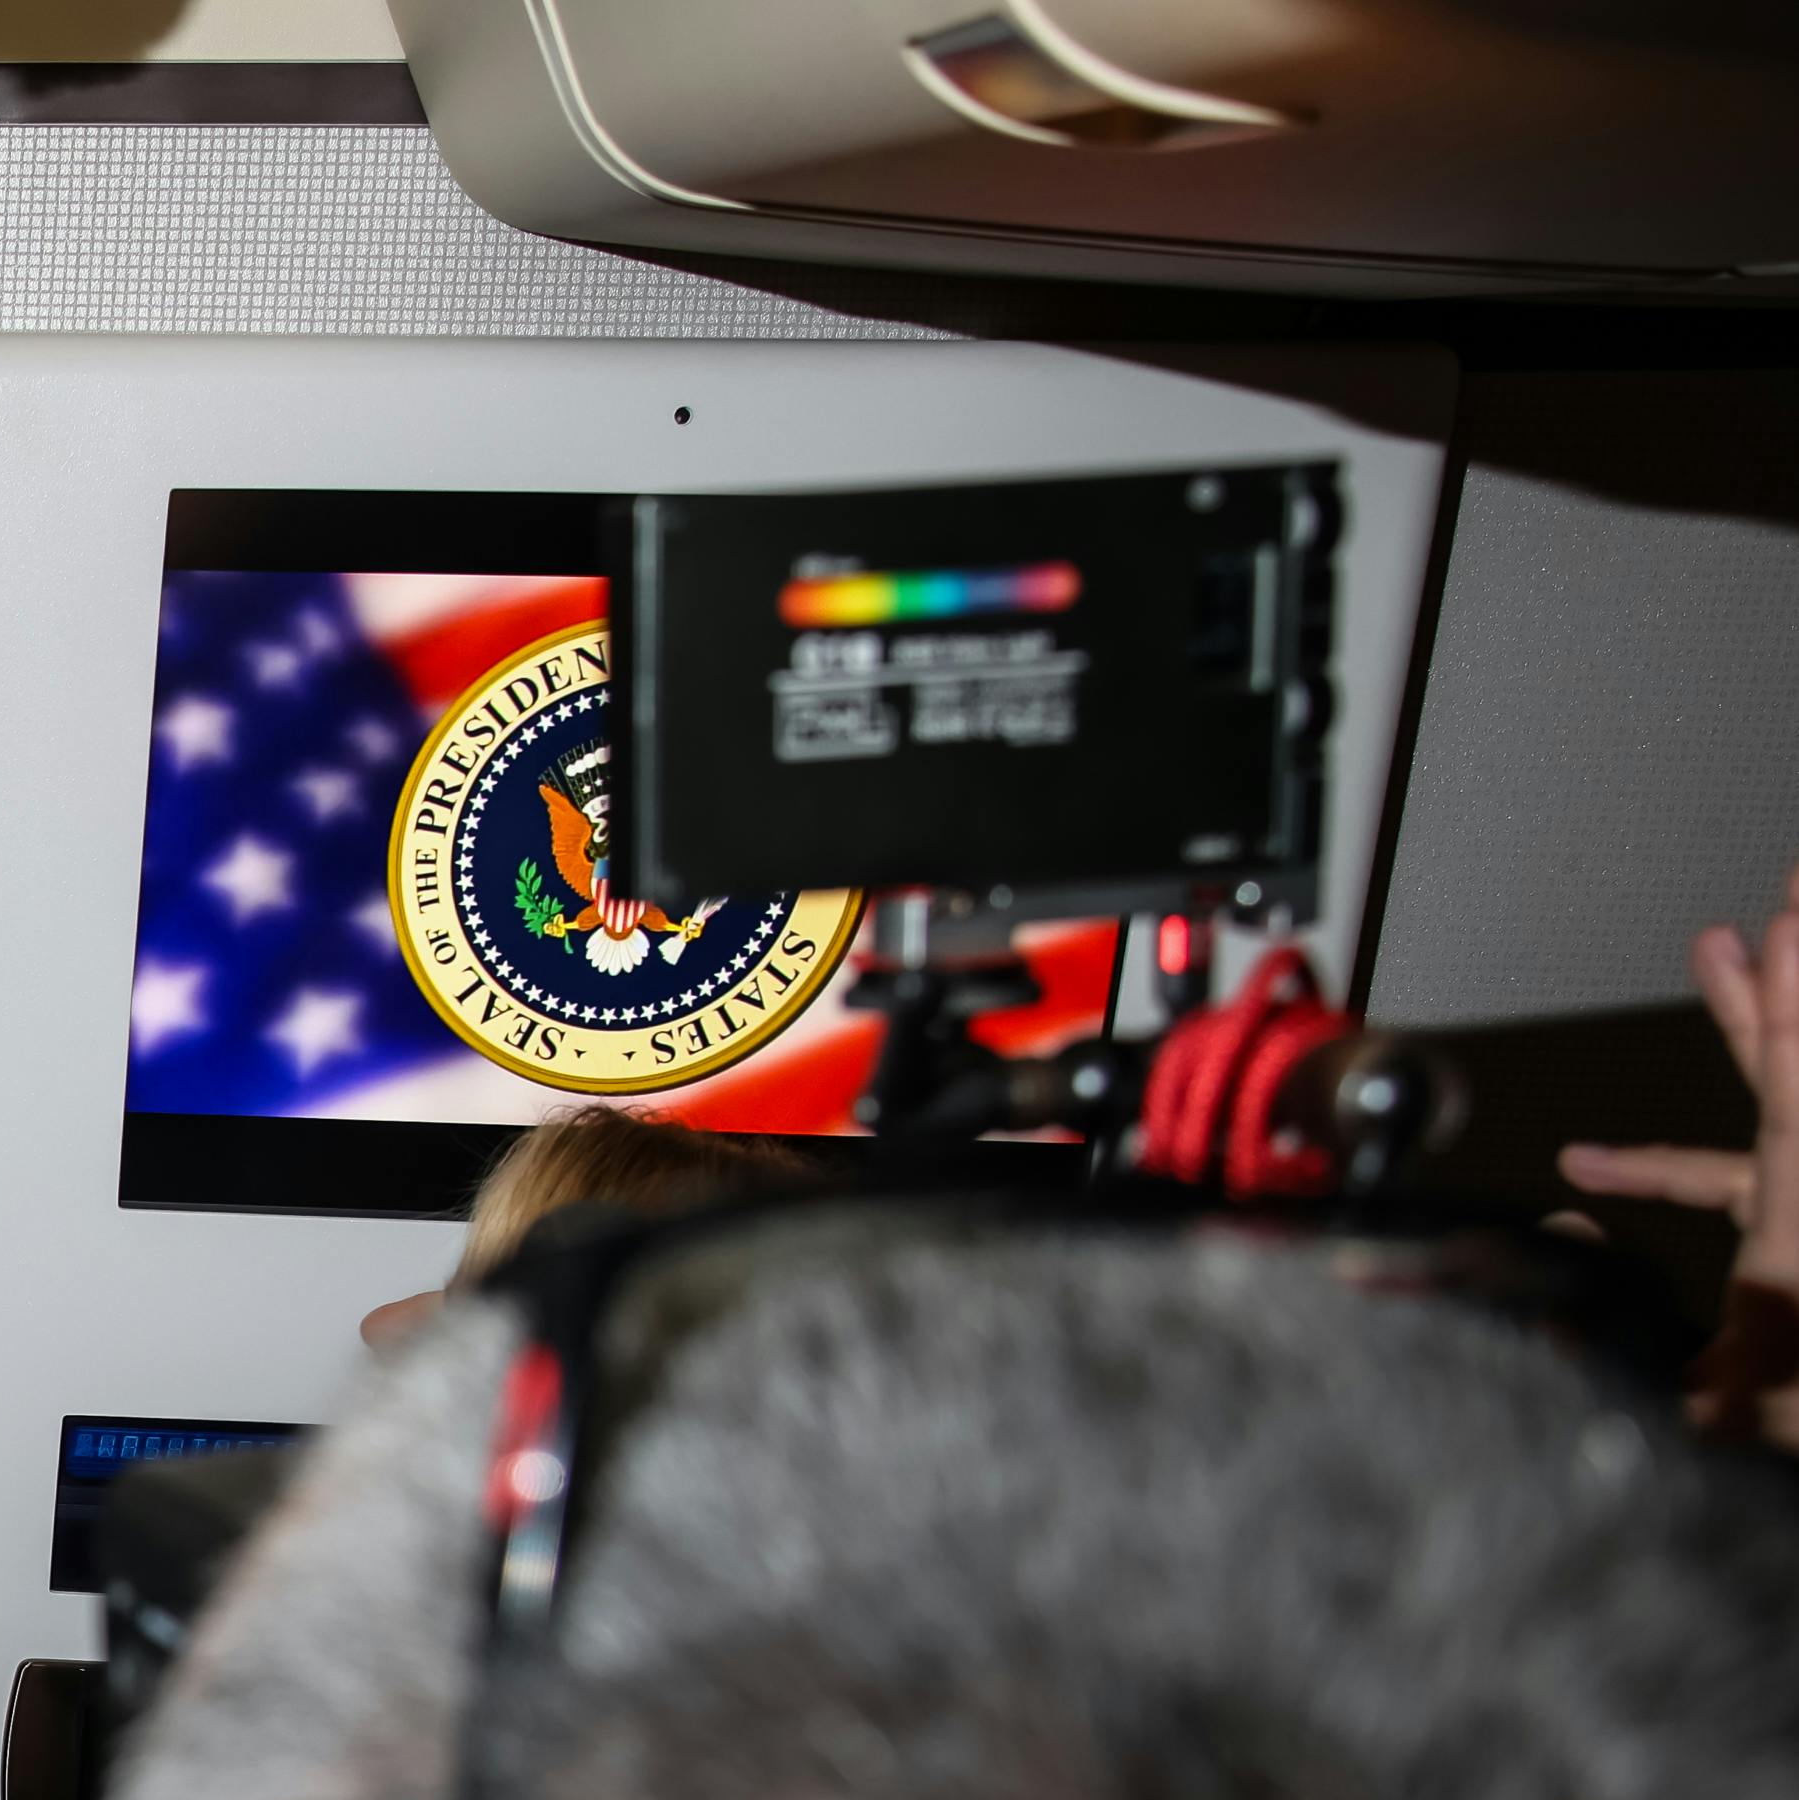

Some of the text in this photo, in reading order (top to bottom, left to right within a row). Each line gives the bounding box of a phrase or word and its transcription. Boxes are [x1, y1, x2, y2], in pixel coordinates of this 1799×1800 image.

[414, 640, 816, 1064] SEAL OF THE PRESIDEN STATES
